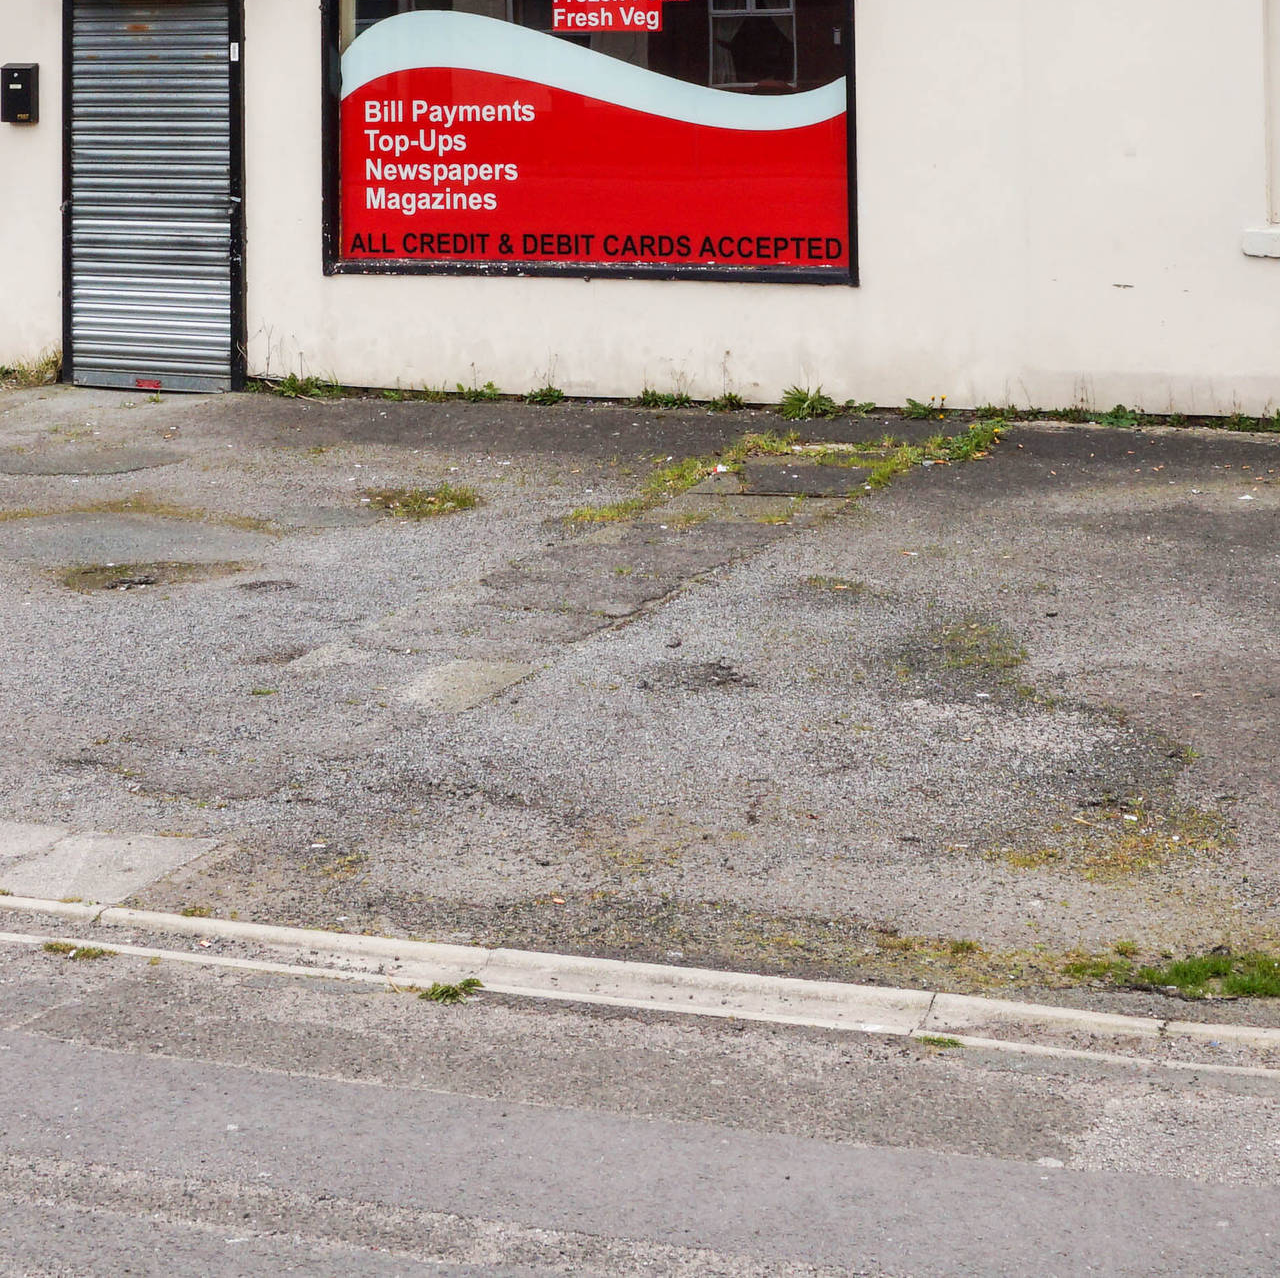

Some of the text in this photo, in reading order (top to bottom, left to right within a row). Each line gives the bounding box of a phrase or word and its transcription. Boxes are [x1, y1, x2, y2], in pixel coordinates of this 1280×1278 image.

[553, 6, 659, 30] Fresh Veg
[364, 99, 536, 128] Bill Payments
[363, 128, 467, 157] Top-Ups
[365, 158, 519, 187] Newspapers
[366, 187, 497, 216] Magazines
[350, 232, 843, 260] ALL CREDIT & DEBIT CARDS ACCEPTED
